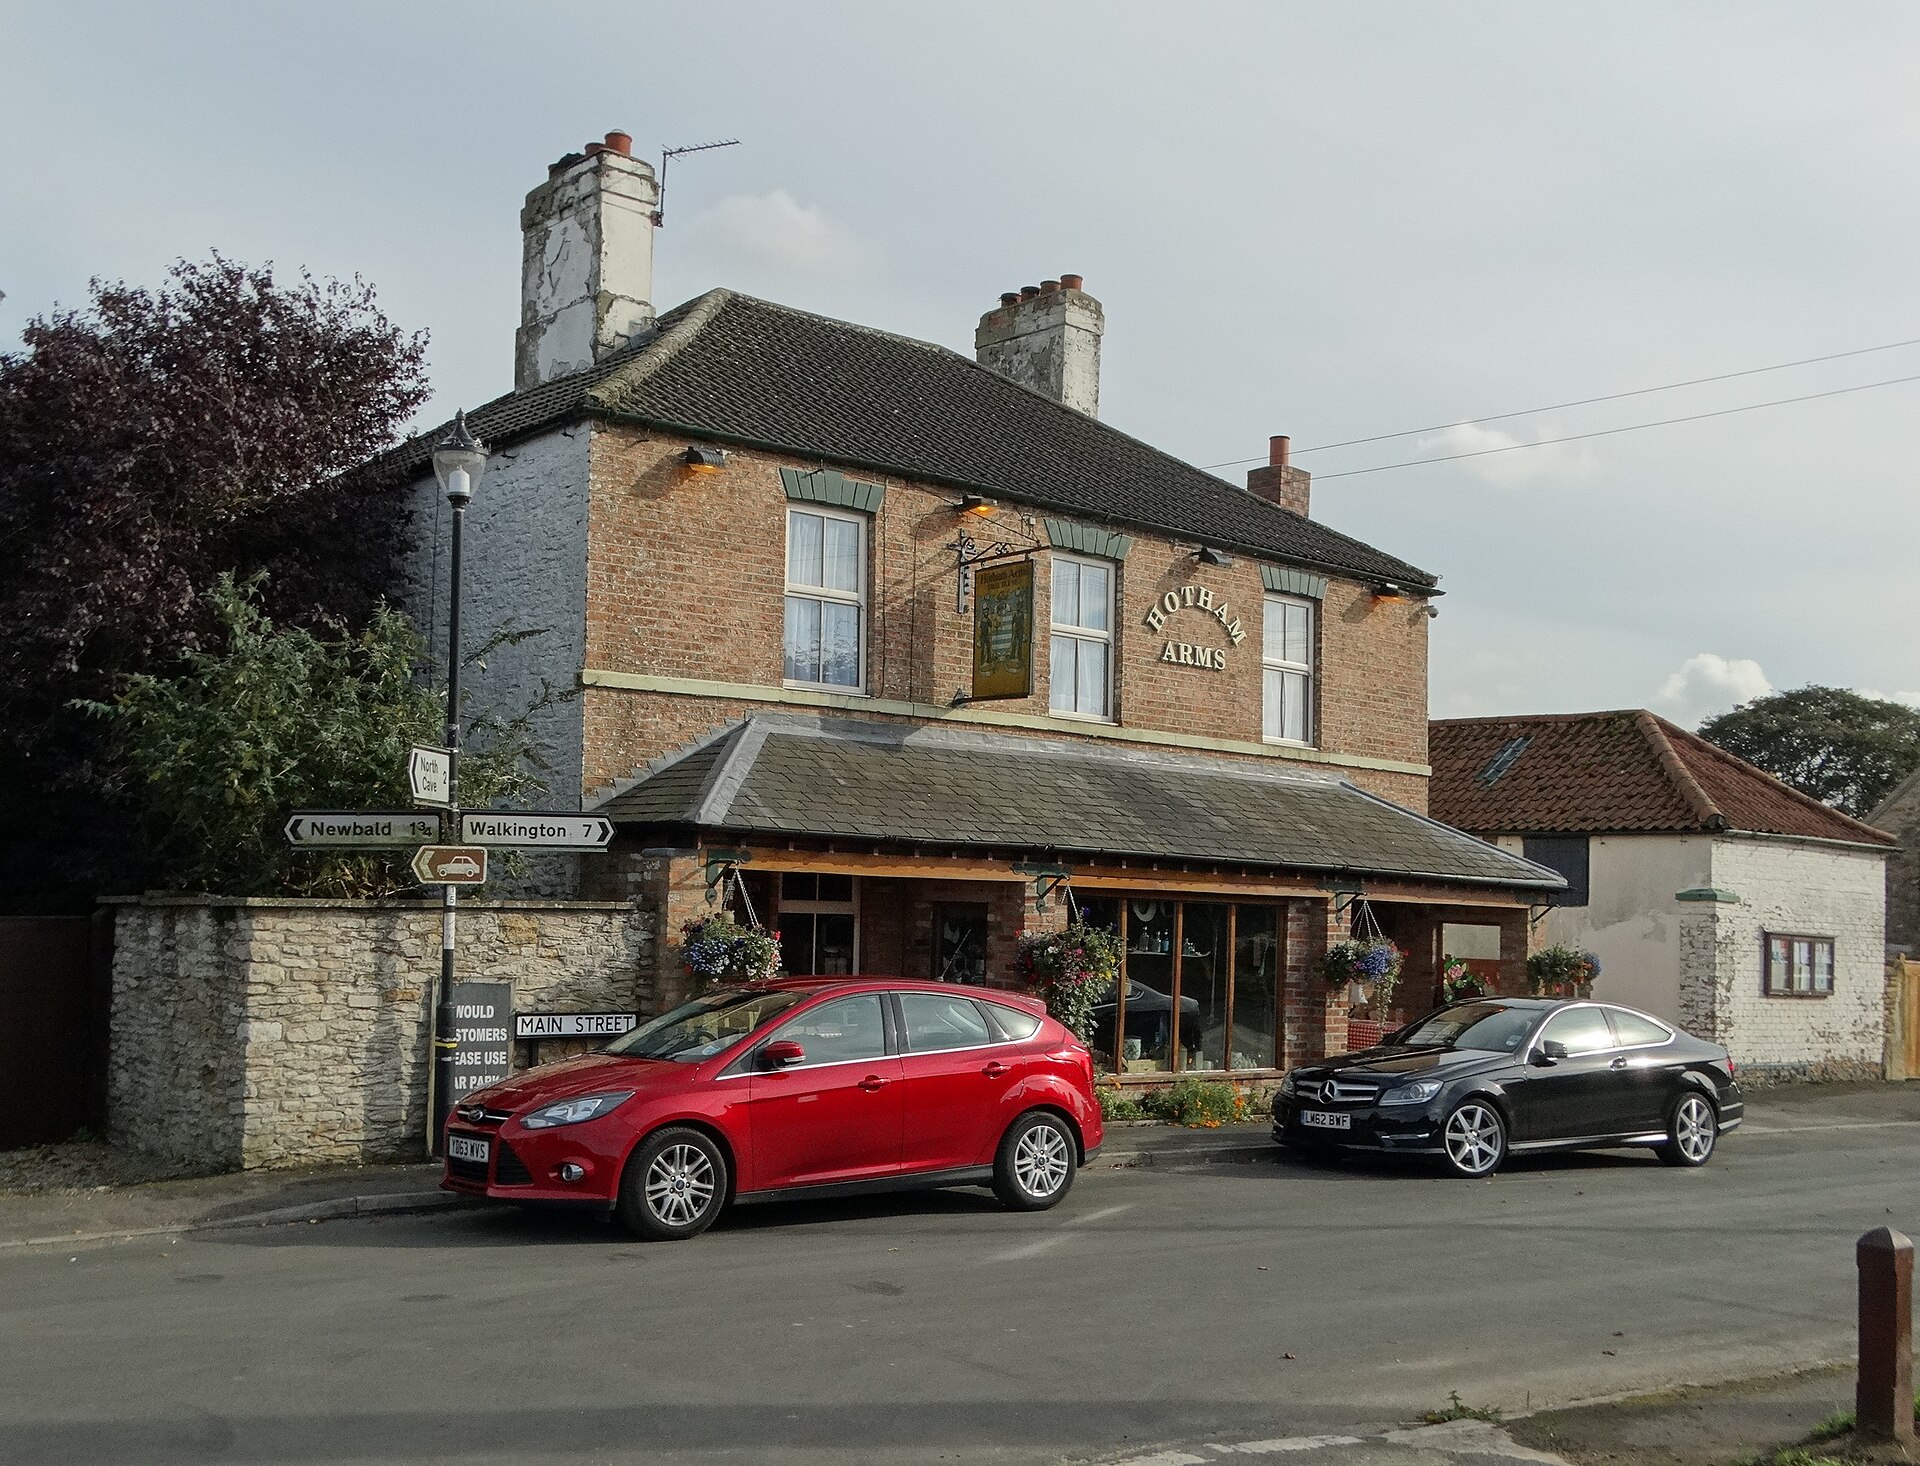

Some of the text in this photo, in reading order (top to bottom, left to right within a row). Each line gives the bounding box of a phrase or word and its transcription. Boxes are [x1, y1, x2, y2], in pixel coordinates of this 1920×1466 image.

[1147, 586, 1247, 647] HOTHAM
[1162, 641, 1226, 670] ARMS
[420, 757, 438, 773] North
[422, 776, 437, 792] Cave
[442, 770, 448, 785] 2
[311, 821, 392, 836] Newbald
[470, 822, 592, 839] Walkington 7
[521, 1016, 633, 1033] MAIN STREET
[455, 1028, 508, 1042] STOMERS
[455, 1051, 507, 1065] EASE USE
